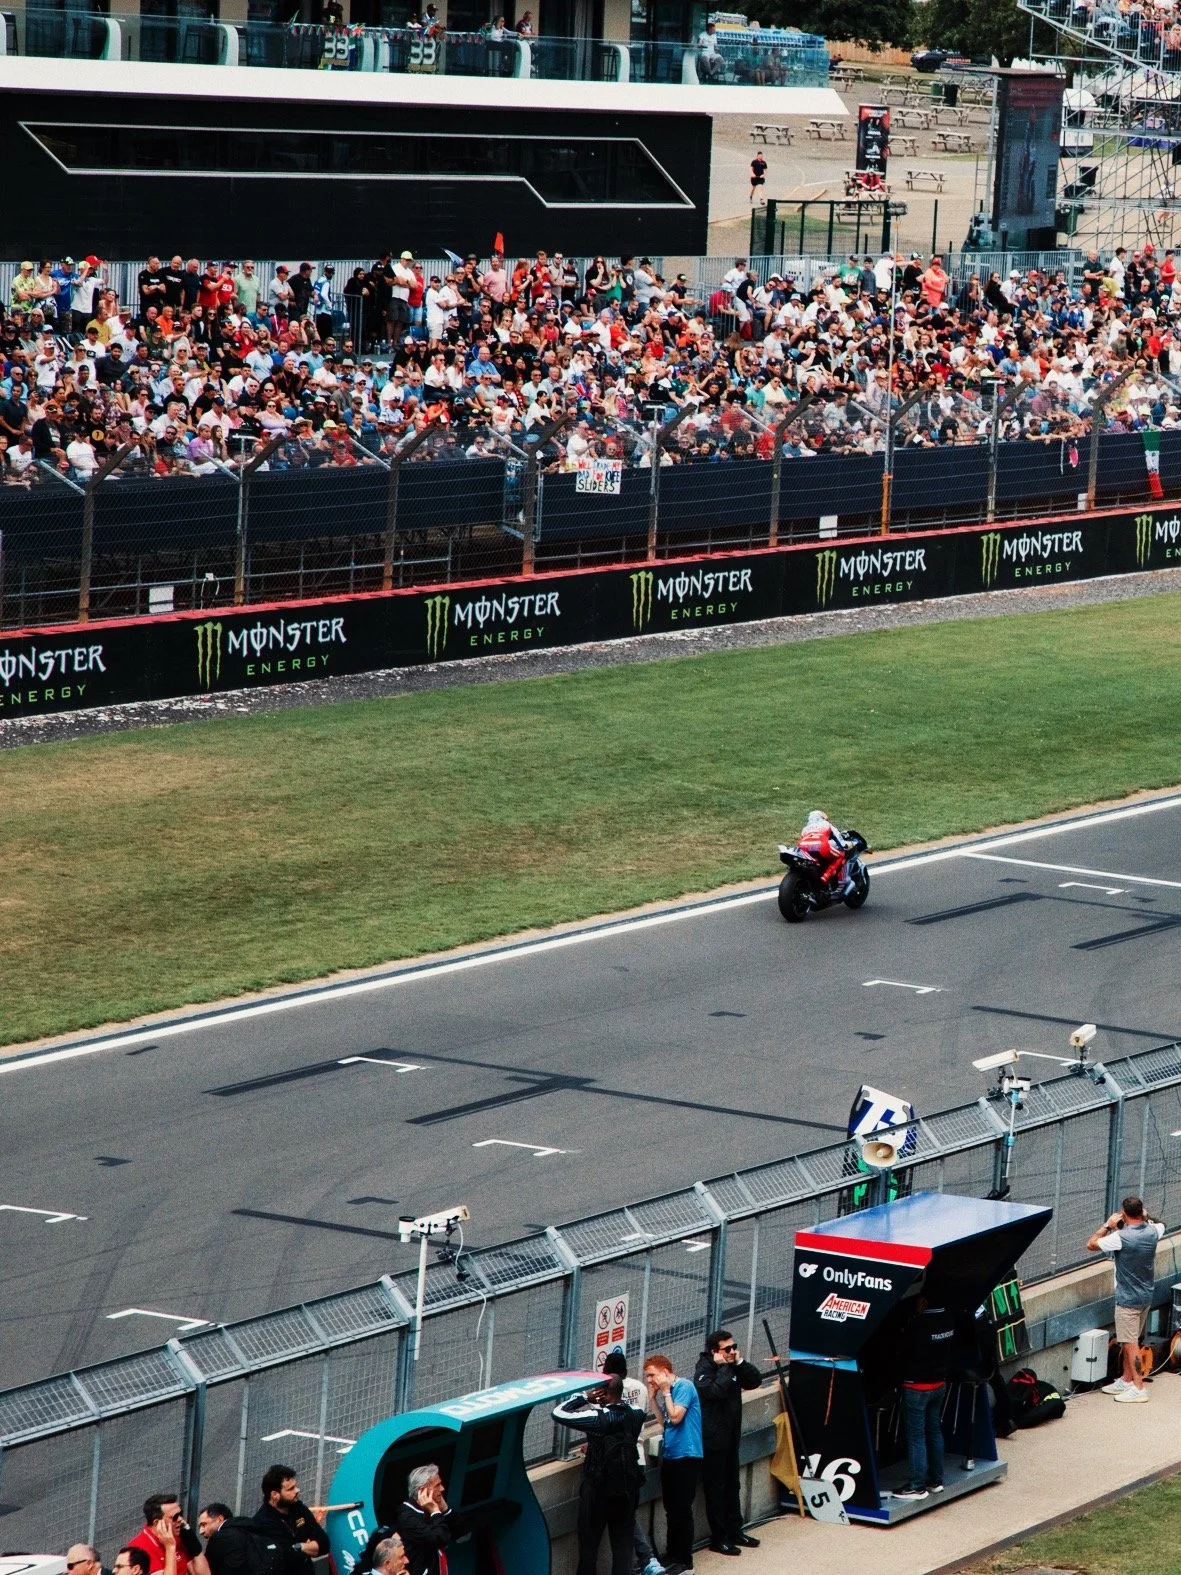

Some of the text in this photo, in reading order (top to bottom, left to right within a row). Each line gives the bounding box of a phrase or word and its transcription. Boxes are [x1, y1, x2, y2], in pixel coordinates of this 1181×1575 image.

[577, 478, 615, 493] SLIDERS
[1002, 531, 1084, 562] MONSTER
[839, 549, 927, 581] MONSTER
[1015, 562, 1072, 578] ENERGY
[657, 569, 754, 604] MONSTER
[852, 581, 914, 597] ENERGY
[454, 591, 562, 629] MONSTER
[671, 602, 739, 620] ENERGY
[228, 617, 348, 658] MONSTER
[470, 627, 546, 647] ENERGY
[0, 645, 106, 688] ONSTER
[247, 655, 330, 676] ENERGY
[823, 1266, 893, 1291] OnlyFans
[824, 1293, 868, 1315] AMERICAN
[824, 1308, 847, 1321] RACING
[810, 1491, 830, 1508] 5
